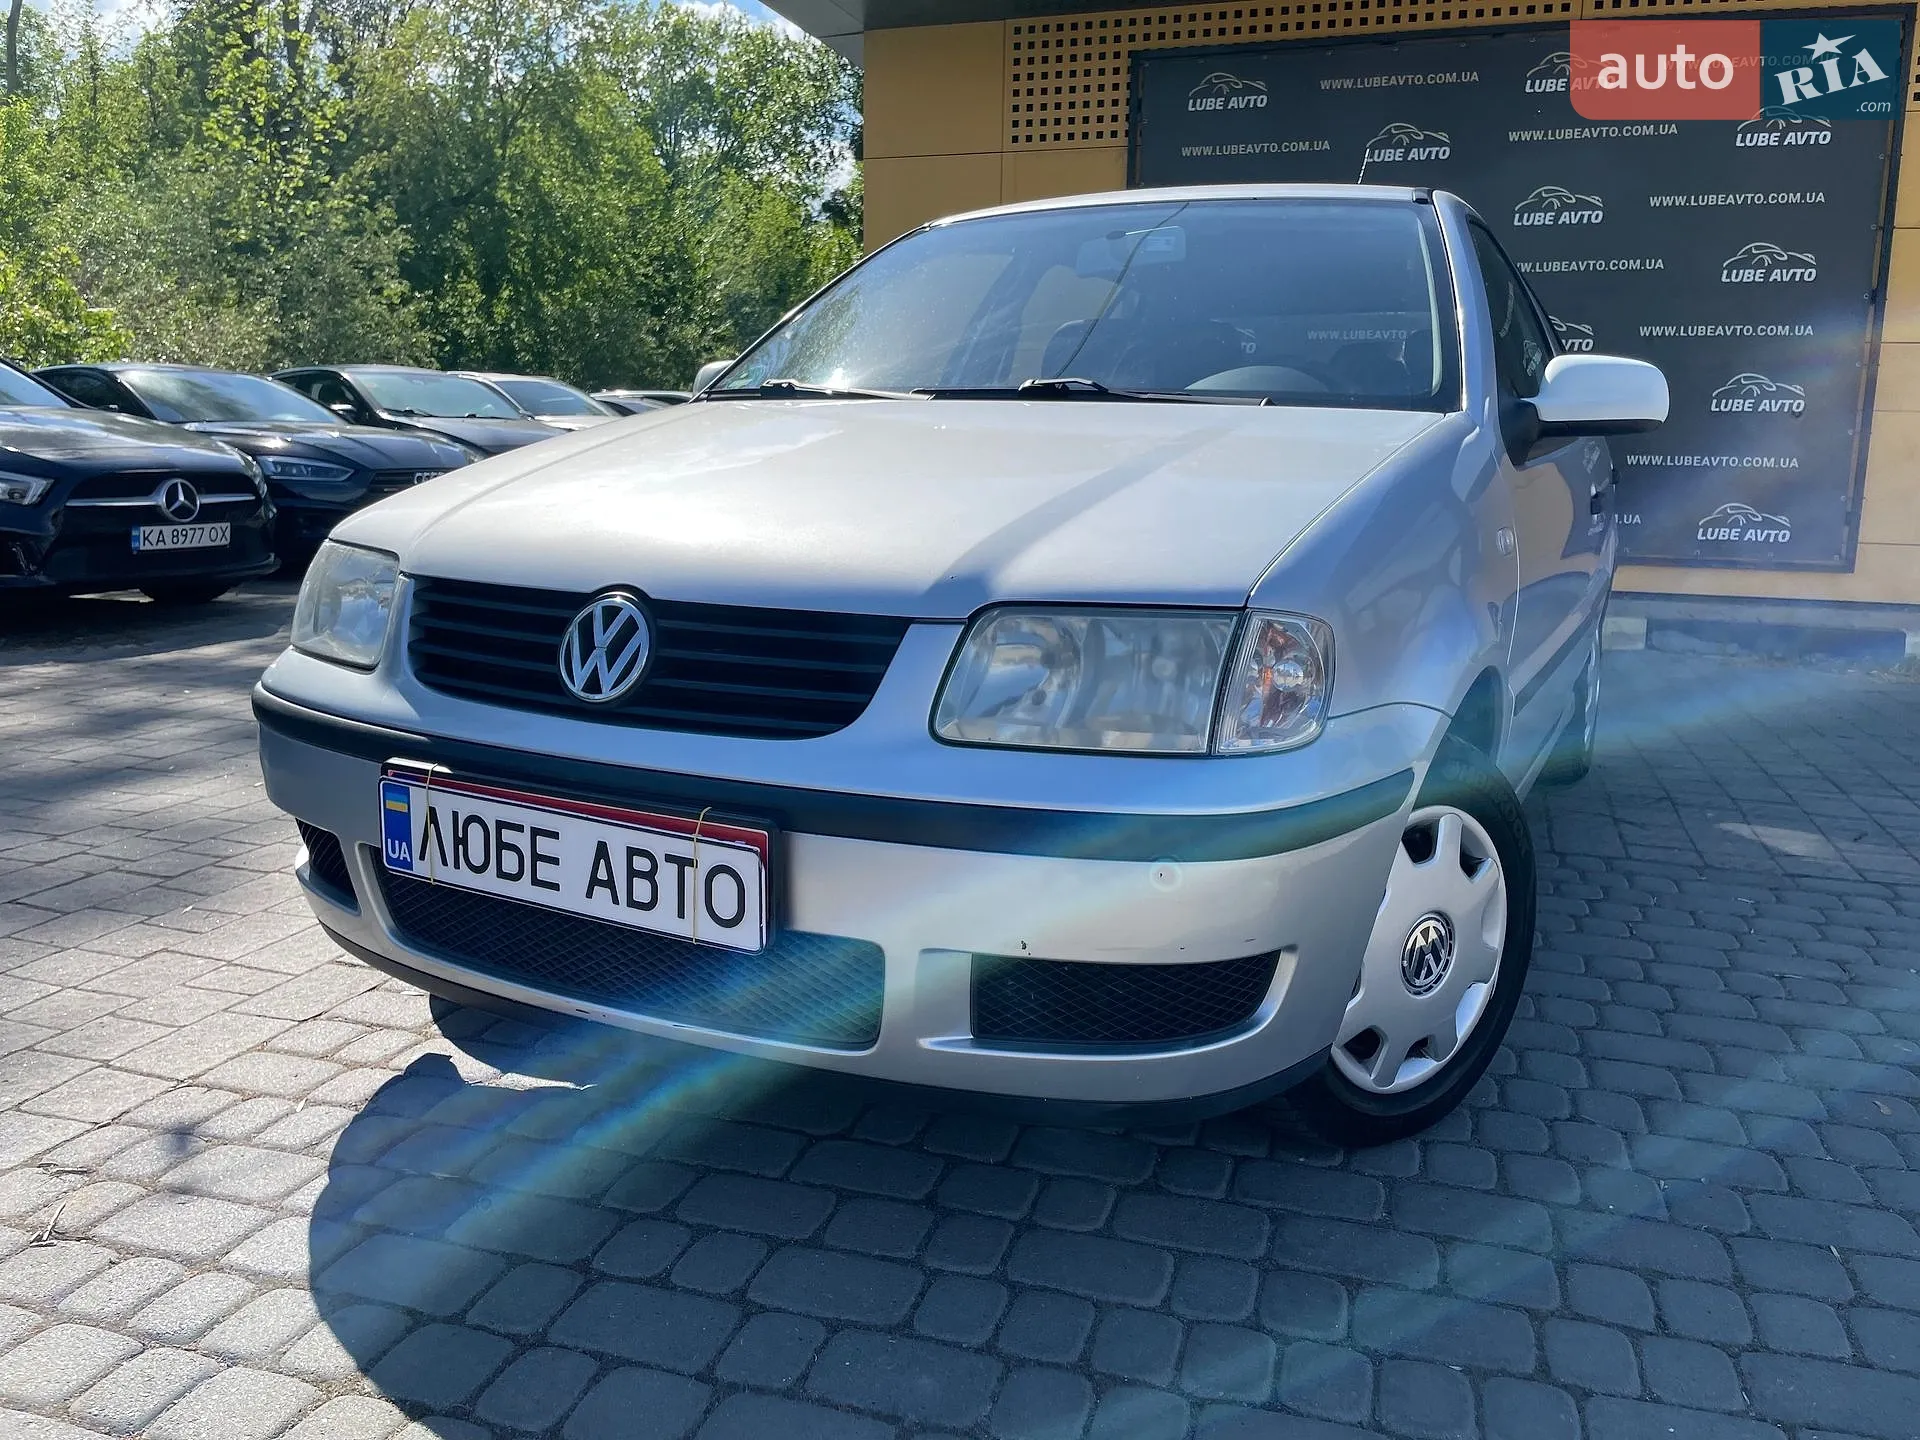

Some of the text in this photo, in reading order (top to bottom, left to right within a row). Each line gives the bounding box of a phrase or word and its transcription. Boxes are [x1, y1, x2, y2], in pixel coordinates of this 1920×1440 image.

[1320, 71, 1480, 90] WWW.LUBEAVTO.COM.UA
[1525, 78, 1567, 93] LUBE
[1187, 95, 1268, 112] LUBE AVTO
[1508, 123, 1679, 142] WWW.LUBEAVTO.COM.UA
[1736, 130, 1832, 147] LUBE AVTO
[1181, 139, 1331, 156] WWW.LUBEAVTO.COM.UA
[1407, 147, 1450, 161] AVTO
[1650, 191, 1825, 207] WWW.LUBEAVTO.COM.UA
[1513, 209, 1604, 226] LUBE AVTO
[1516, 258, 1664, 273] W.LUBEAVTO.COM.UA
[1721, 267, 1817, 283] LUBE AVTO
[1640, 325, 1814, 337] WWW.LUBEAVTO.COM.UA
[1562, 338, 1594, 351] VTO
[1711, 399, 1806, 413] LUBE AVTO
[1627, 455, 1799, 469] WWW.LUBEAVTO.COM.UA
[142, 528, 166, 546] KA
[171, 527, 205, 545] 8977
[208, 525, 229, 543] OX
[1698, 527, 1791, 543] LUBE AVTO
[387, 838, 411, 862] UA
[585, 840, 746, 929] АВТО
